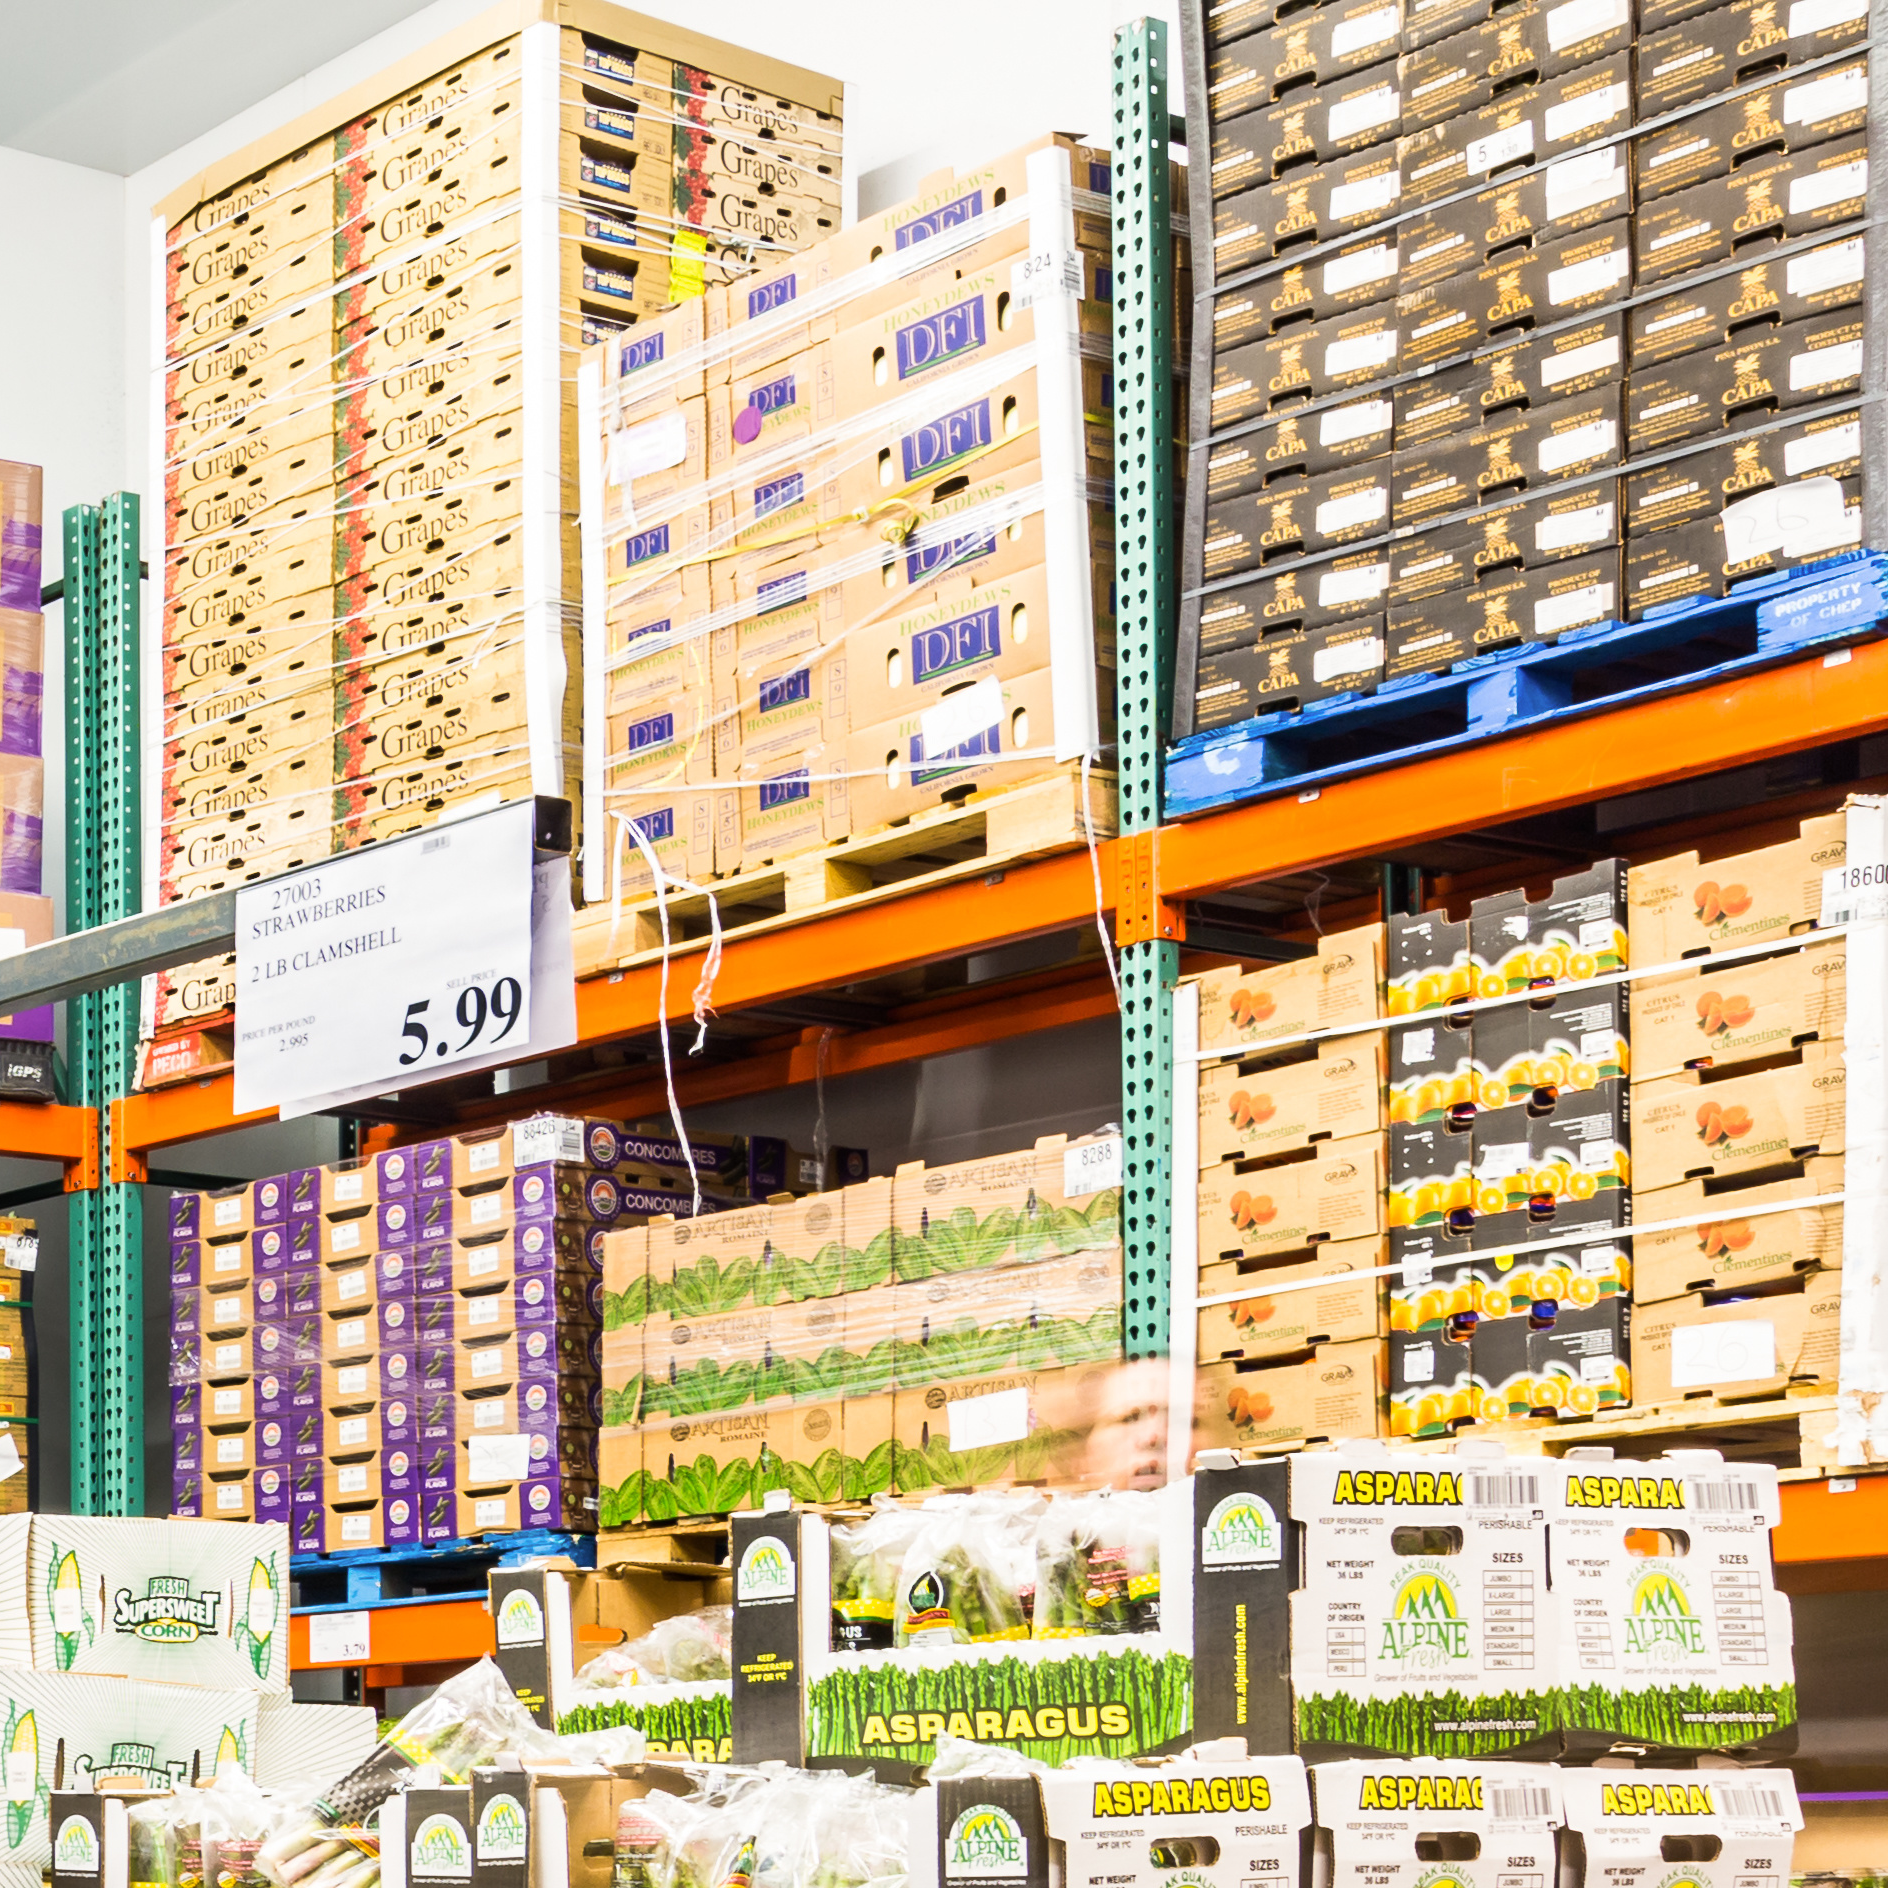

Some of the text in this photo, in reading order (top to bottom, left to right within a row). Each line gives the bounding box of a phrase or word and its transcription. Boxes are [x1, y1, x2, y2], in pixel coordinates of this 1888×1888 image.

[1486, 218, 1533, 242] CAPA
[884, 274, 996, 335] HONEYDEWS
[905, 302, 980, 375] DFI
[1775, 581, 1863, 616] PROPERTY
[742, 602, 821, 636] HONEYDEWS
[1789, 596, 1864, 628] OF CHEP
[1257, 671, 1299, 694] CAPA
[381, 712, 469, 759] Grapes
[272, 879, 321, 909] 27003
[252, 886, 386, 940] STRAWBERRIES
[1709, 913, 1791, 941] Clementines
[252, 927, 402, 982] 2 LB CLAMSHELL
[446, 969, 497, 990] SELL PRICE
[1646, 995, 1681, 1009] CITRUS
[242, 1016, 315, 1042] PRICE PER POUND
[399, 976, 522, 1065] 5.99
[279, 1033, 309, 1052] 2.995
[524, 1120, 555, 1140] 88426
[626, 1195, 716, 1216] CONCOMBES
[720, 1431, 767, 1443] ROMAINE
[1319, 1517, 1334, 1525] KEEP
[1478, 1520, 1532, 1529] PERISHABLE
[1343, 1560, 1374, 1568] WEIGHT
[1492, 1553, 1523, 1563] SIZES
[152, 1577, 188, 1598] FRESH
[1488, 1591, 1516, 1599] X-LARGE
[113, 1590, 220, 1629] SUPERSWEET
[1328, 1602, 1361, 1611] COUNTRY
[1327, 1614, 1365, 1622] OF ORIGEN
[140, 1624, 193, 1639] CORN
[1378, 1622, 1470, 1659] ALPINE
[343, 1642, 366, 1657] 3.79
[1434, 1719, 1536, 1732] www.alpinefresh.com
[1094, 1776, 1271, 1819] ASPARAGUS
